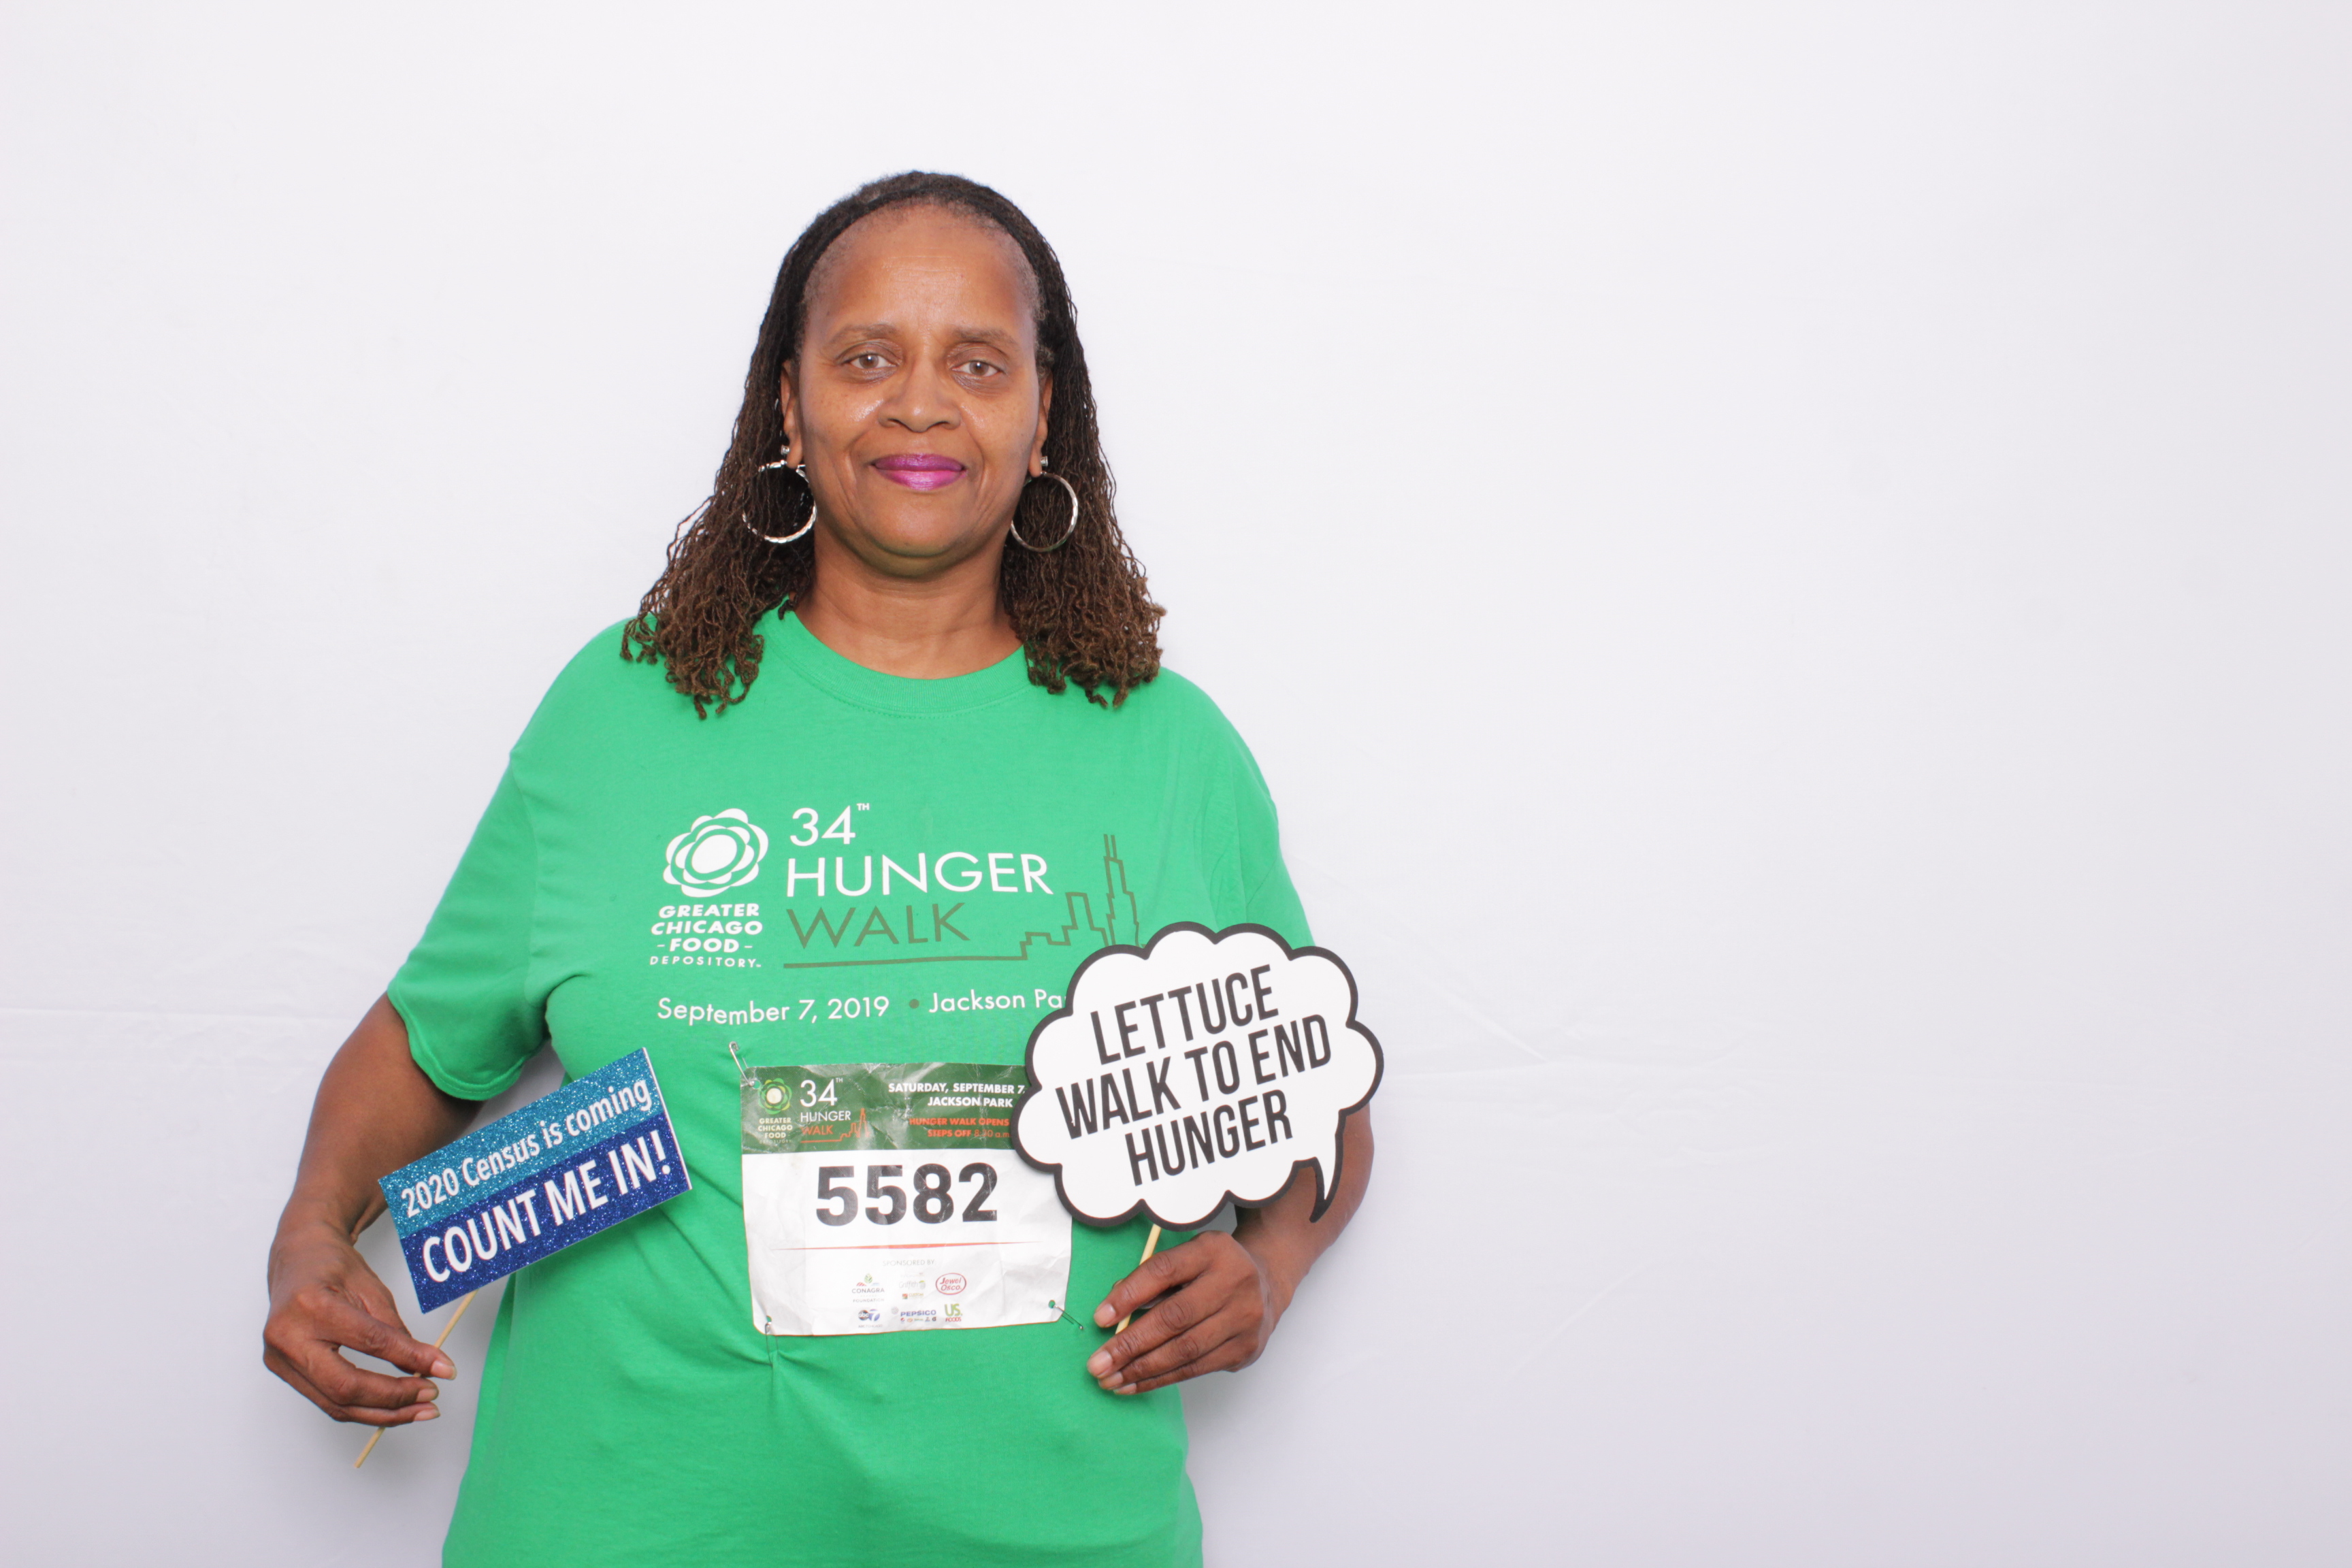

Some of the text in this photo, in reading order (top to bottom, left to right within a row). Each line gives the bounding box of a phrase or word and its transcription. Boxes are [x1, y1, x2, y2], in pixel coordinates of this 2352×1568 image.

[786, 851, 1054, 898] HUNGER
[658, 902, 760, 919] GREATER
[651, 919, 763, 936] CHICAGO
[786, 902, 970, 949] WALK
[657, 996, 889, 1026] September 7, 2019
[928, 988, 1067, 1013] Jackson Pa
[1090, 964, 1279, 1065] LETTUCE
[888, 1083, 949, 1094] SATURDAY,
[953, 1083, 1015, 1094] SEPTEMBER
[1055, 1014, 1332, 1140] WALK TO END
[927, 1096, 1013, 1108] JACKSON PARK
[800, 1110, 851, 1122] HUNGER
[801, 1124, 834, 1135] WALK
[909, 1117, 1010, 1126] HUNGER WALK OPENS
[928, 1129, 953, 1137] STEPS
[954, 1129, 972, 1137] OFF
[974, 1129, 994, 1137] 8:30
[1124, 1089, 1293, 1187] HUNGER
[401, 1079, 653, 1218] 2020 Census is coming
[422, 1129, 672, 1283] COUNT ME IN!
[815, 1162, 998, 1227] 5582
